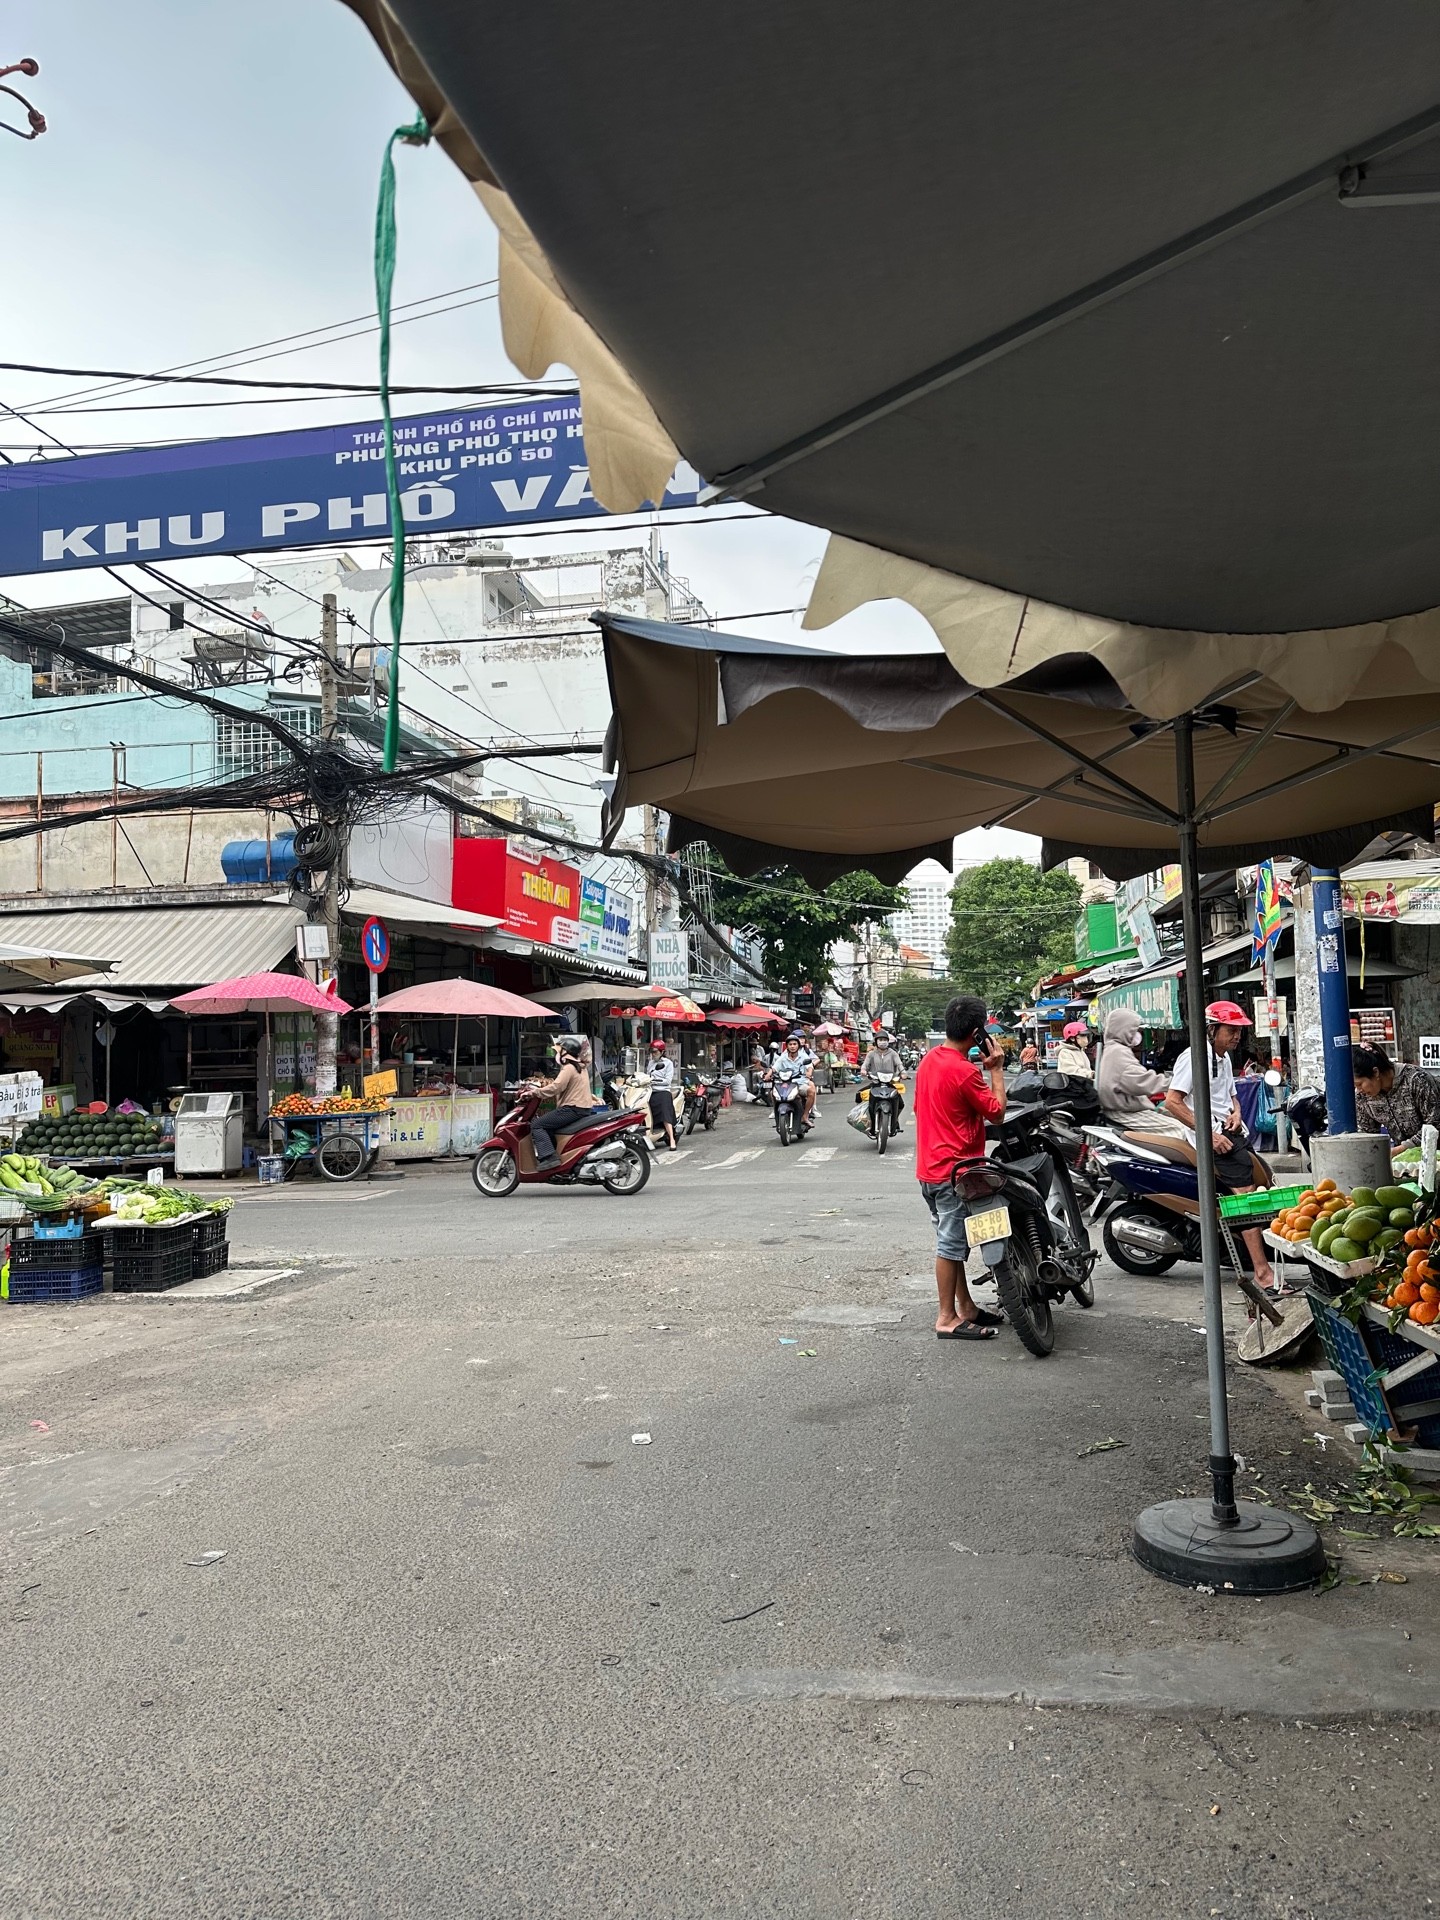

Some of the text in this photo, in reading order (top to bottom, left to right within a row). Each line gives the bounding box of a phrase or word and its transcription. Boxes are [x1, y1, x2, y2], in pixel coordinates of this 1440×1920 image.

[352, 422, 417, 446] THÀNH
[423, 416, 464, 438] PHỐ
[469, 413, 497, 432] HỒ
[502, 410, 538, 427] CHÍ
[335, 439, 440, 465] PHƯỜNG
[449, 429, 500, 452] PHÚ
[508, 426, 558, 447] THỌ
[400, 444, 553, 476] KHU PHỐ 50
[42, 509, 226, 562] KHU
[262, 472, 460, 537] PHỐ
[553, 883, 571, 909] AN
[655, 932, 681, 954] NHÀ
[651, 954, 687, 978] THUỐC
[276, 1057, 289, 1065] CHO
[25, 1087, 30, 1098] 3
[12, 1101, 28, 1113] 10k
[396, 1100, 488, 1123] TƠ TÂY NINH
[400, 1132, 408, 1142] &
[410, 1126, 425, 1141] LẺ
[970, 1211, 1003, 1230] 36-R8
